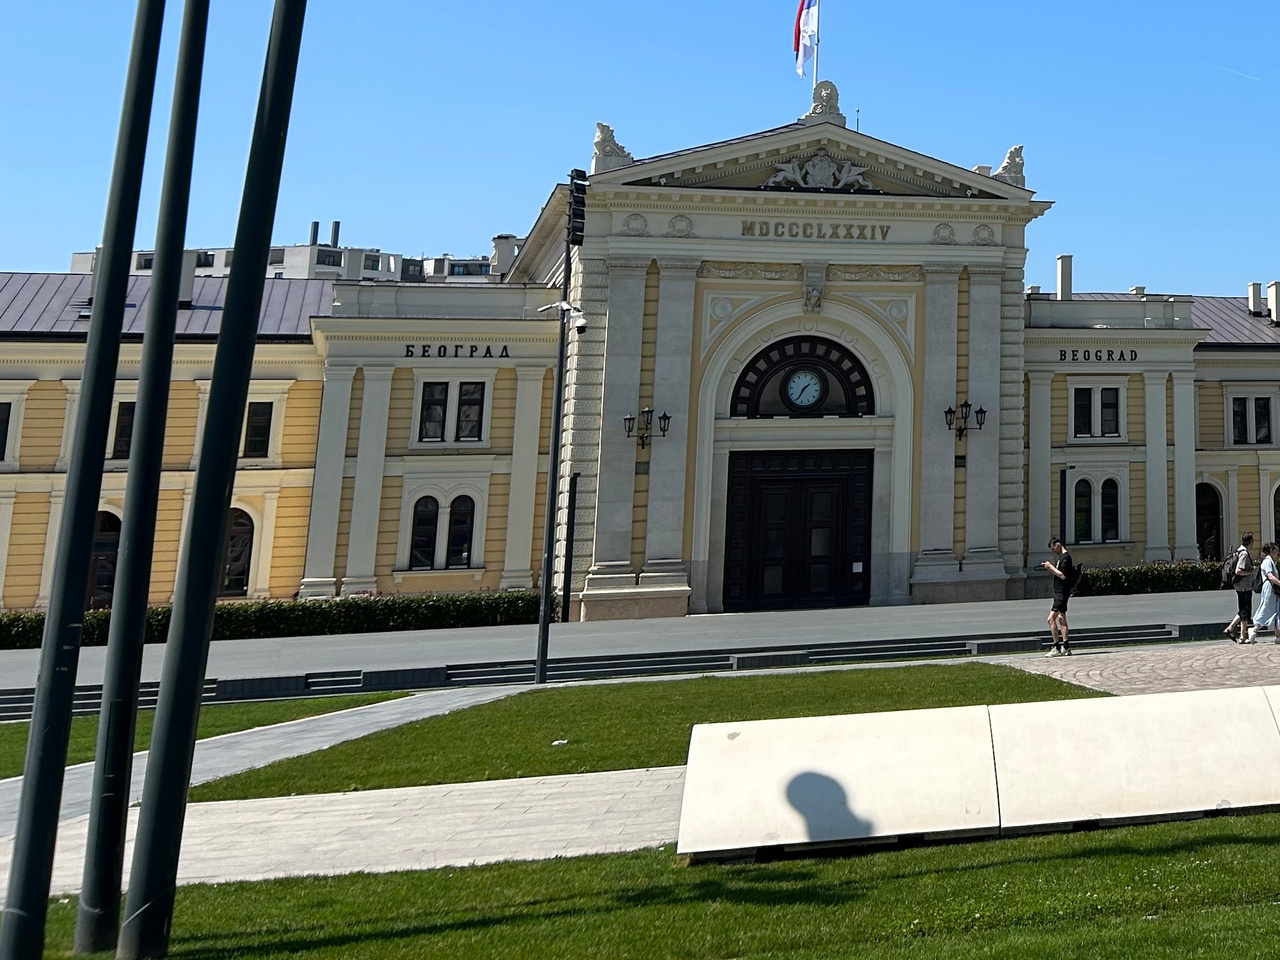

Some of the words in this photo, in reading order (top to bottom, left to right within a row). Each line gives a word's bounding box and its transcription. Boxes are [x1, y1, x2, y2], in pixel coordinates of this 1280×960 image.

[741, 220, 891, 240] MDCCCLXXXIV
[404, 344, 510, 358] БЕОГРАД
[1059, 349, 1138, 361] BEOGRAD
